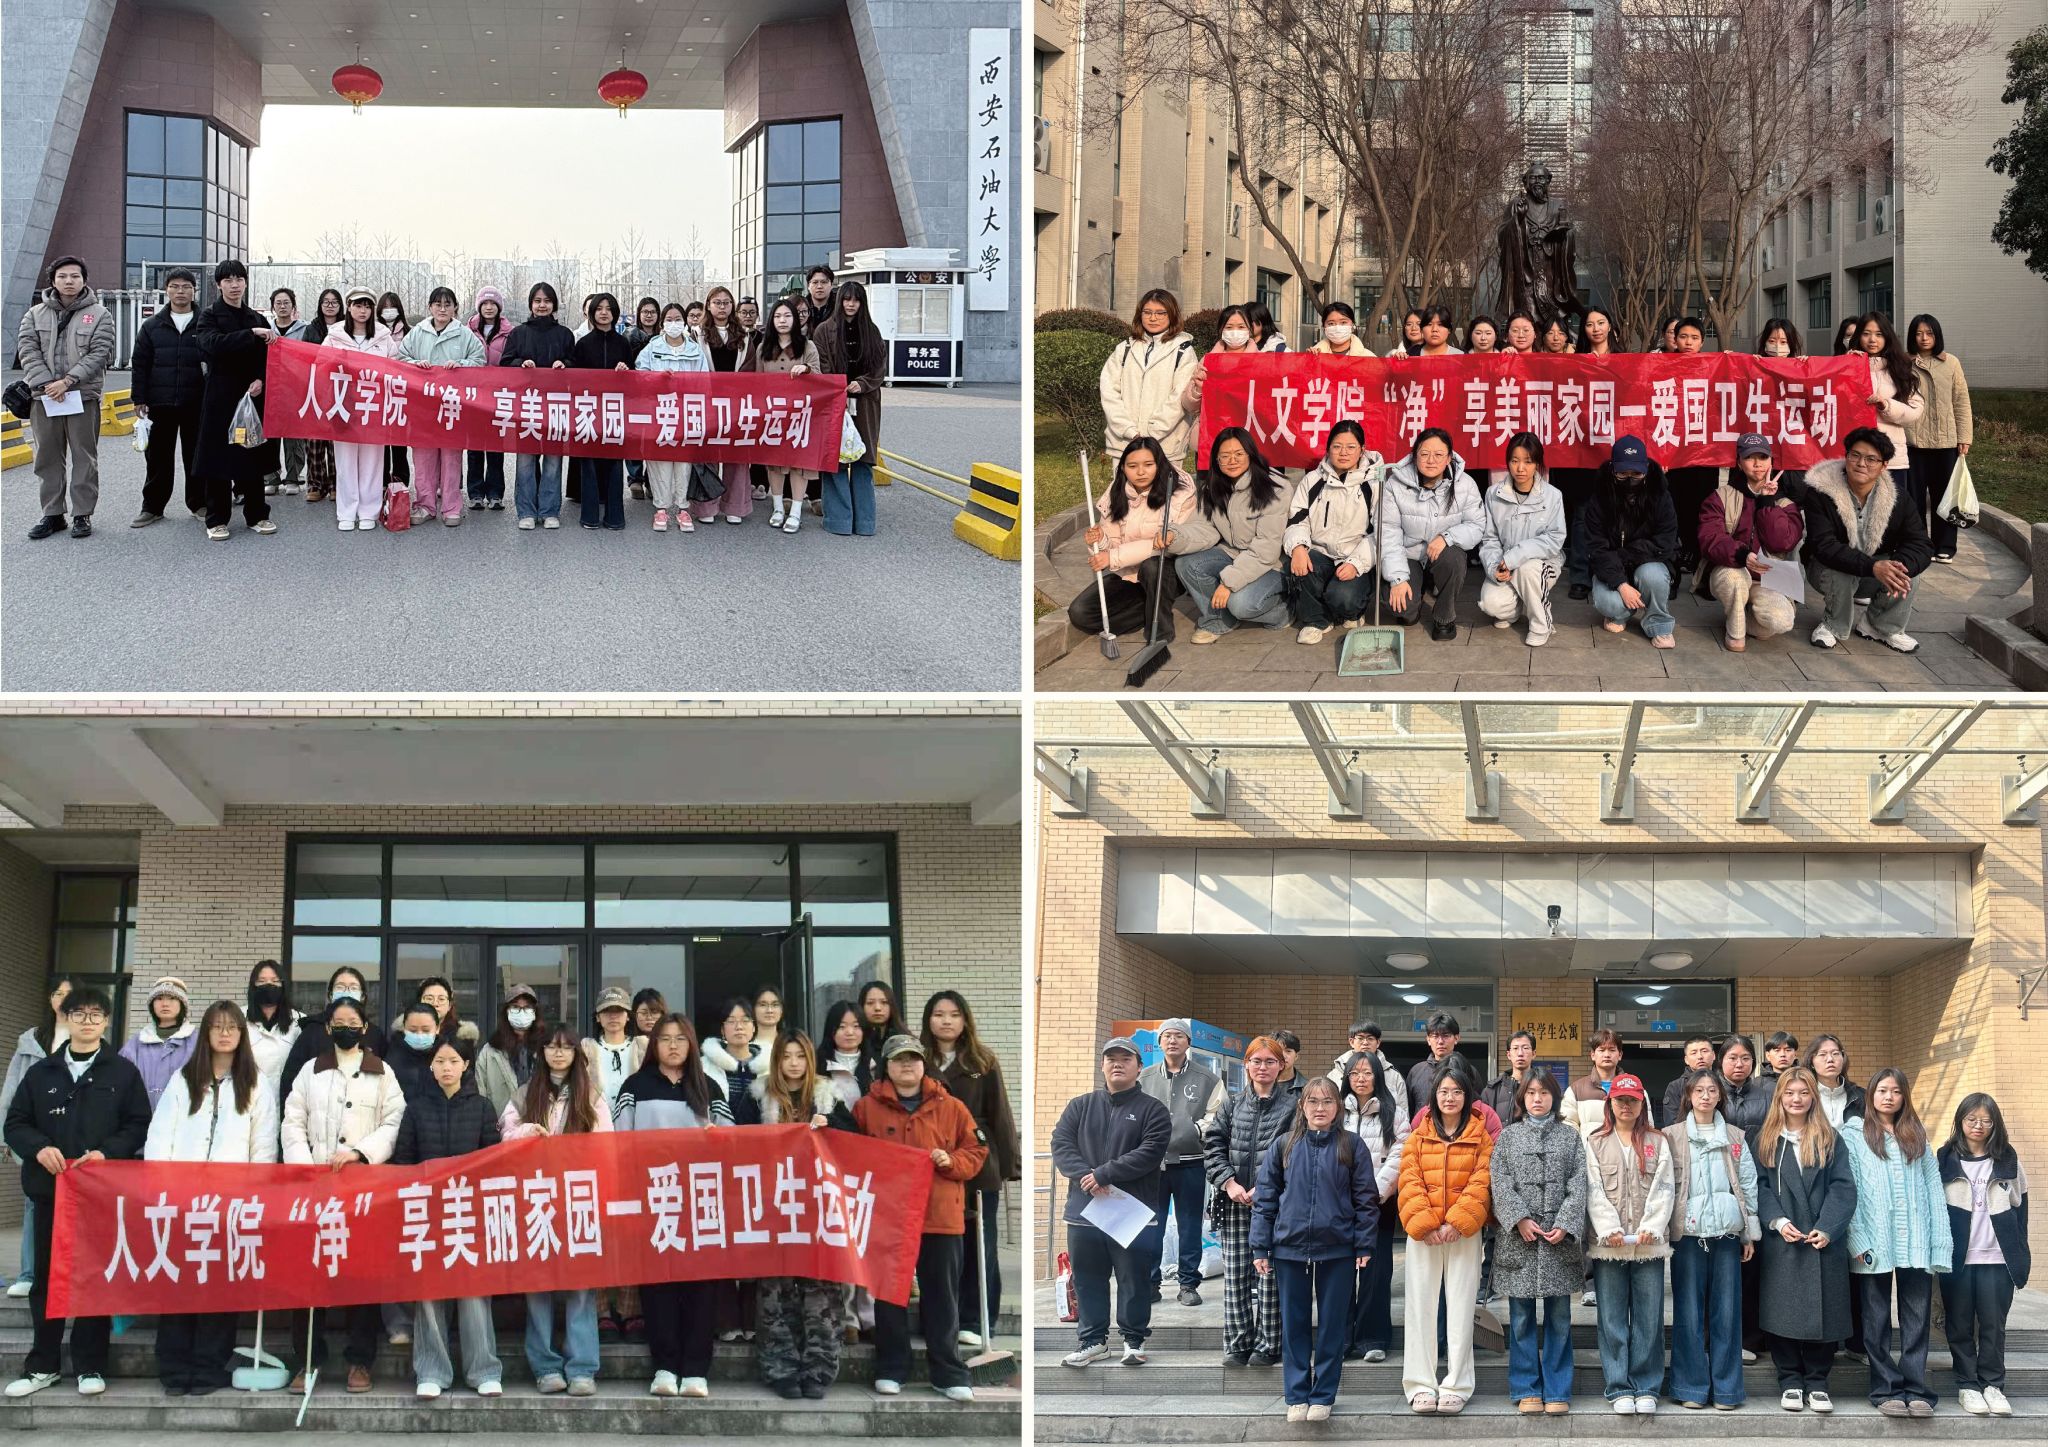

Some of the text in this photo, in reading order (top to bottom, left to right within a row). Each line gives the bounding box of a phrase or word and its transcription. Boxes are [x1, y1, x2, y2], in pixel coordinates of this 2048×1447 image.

[905, 271, 948, 283] 公安
[908, 347, 940, 358] 警务室
[907, 360, 940, 368] POLICE
